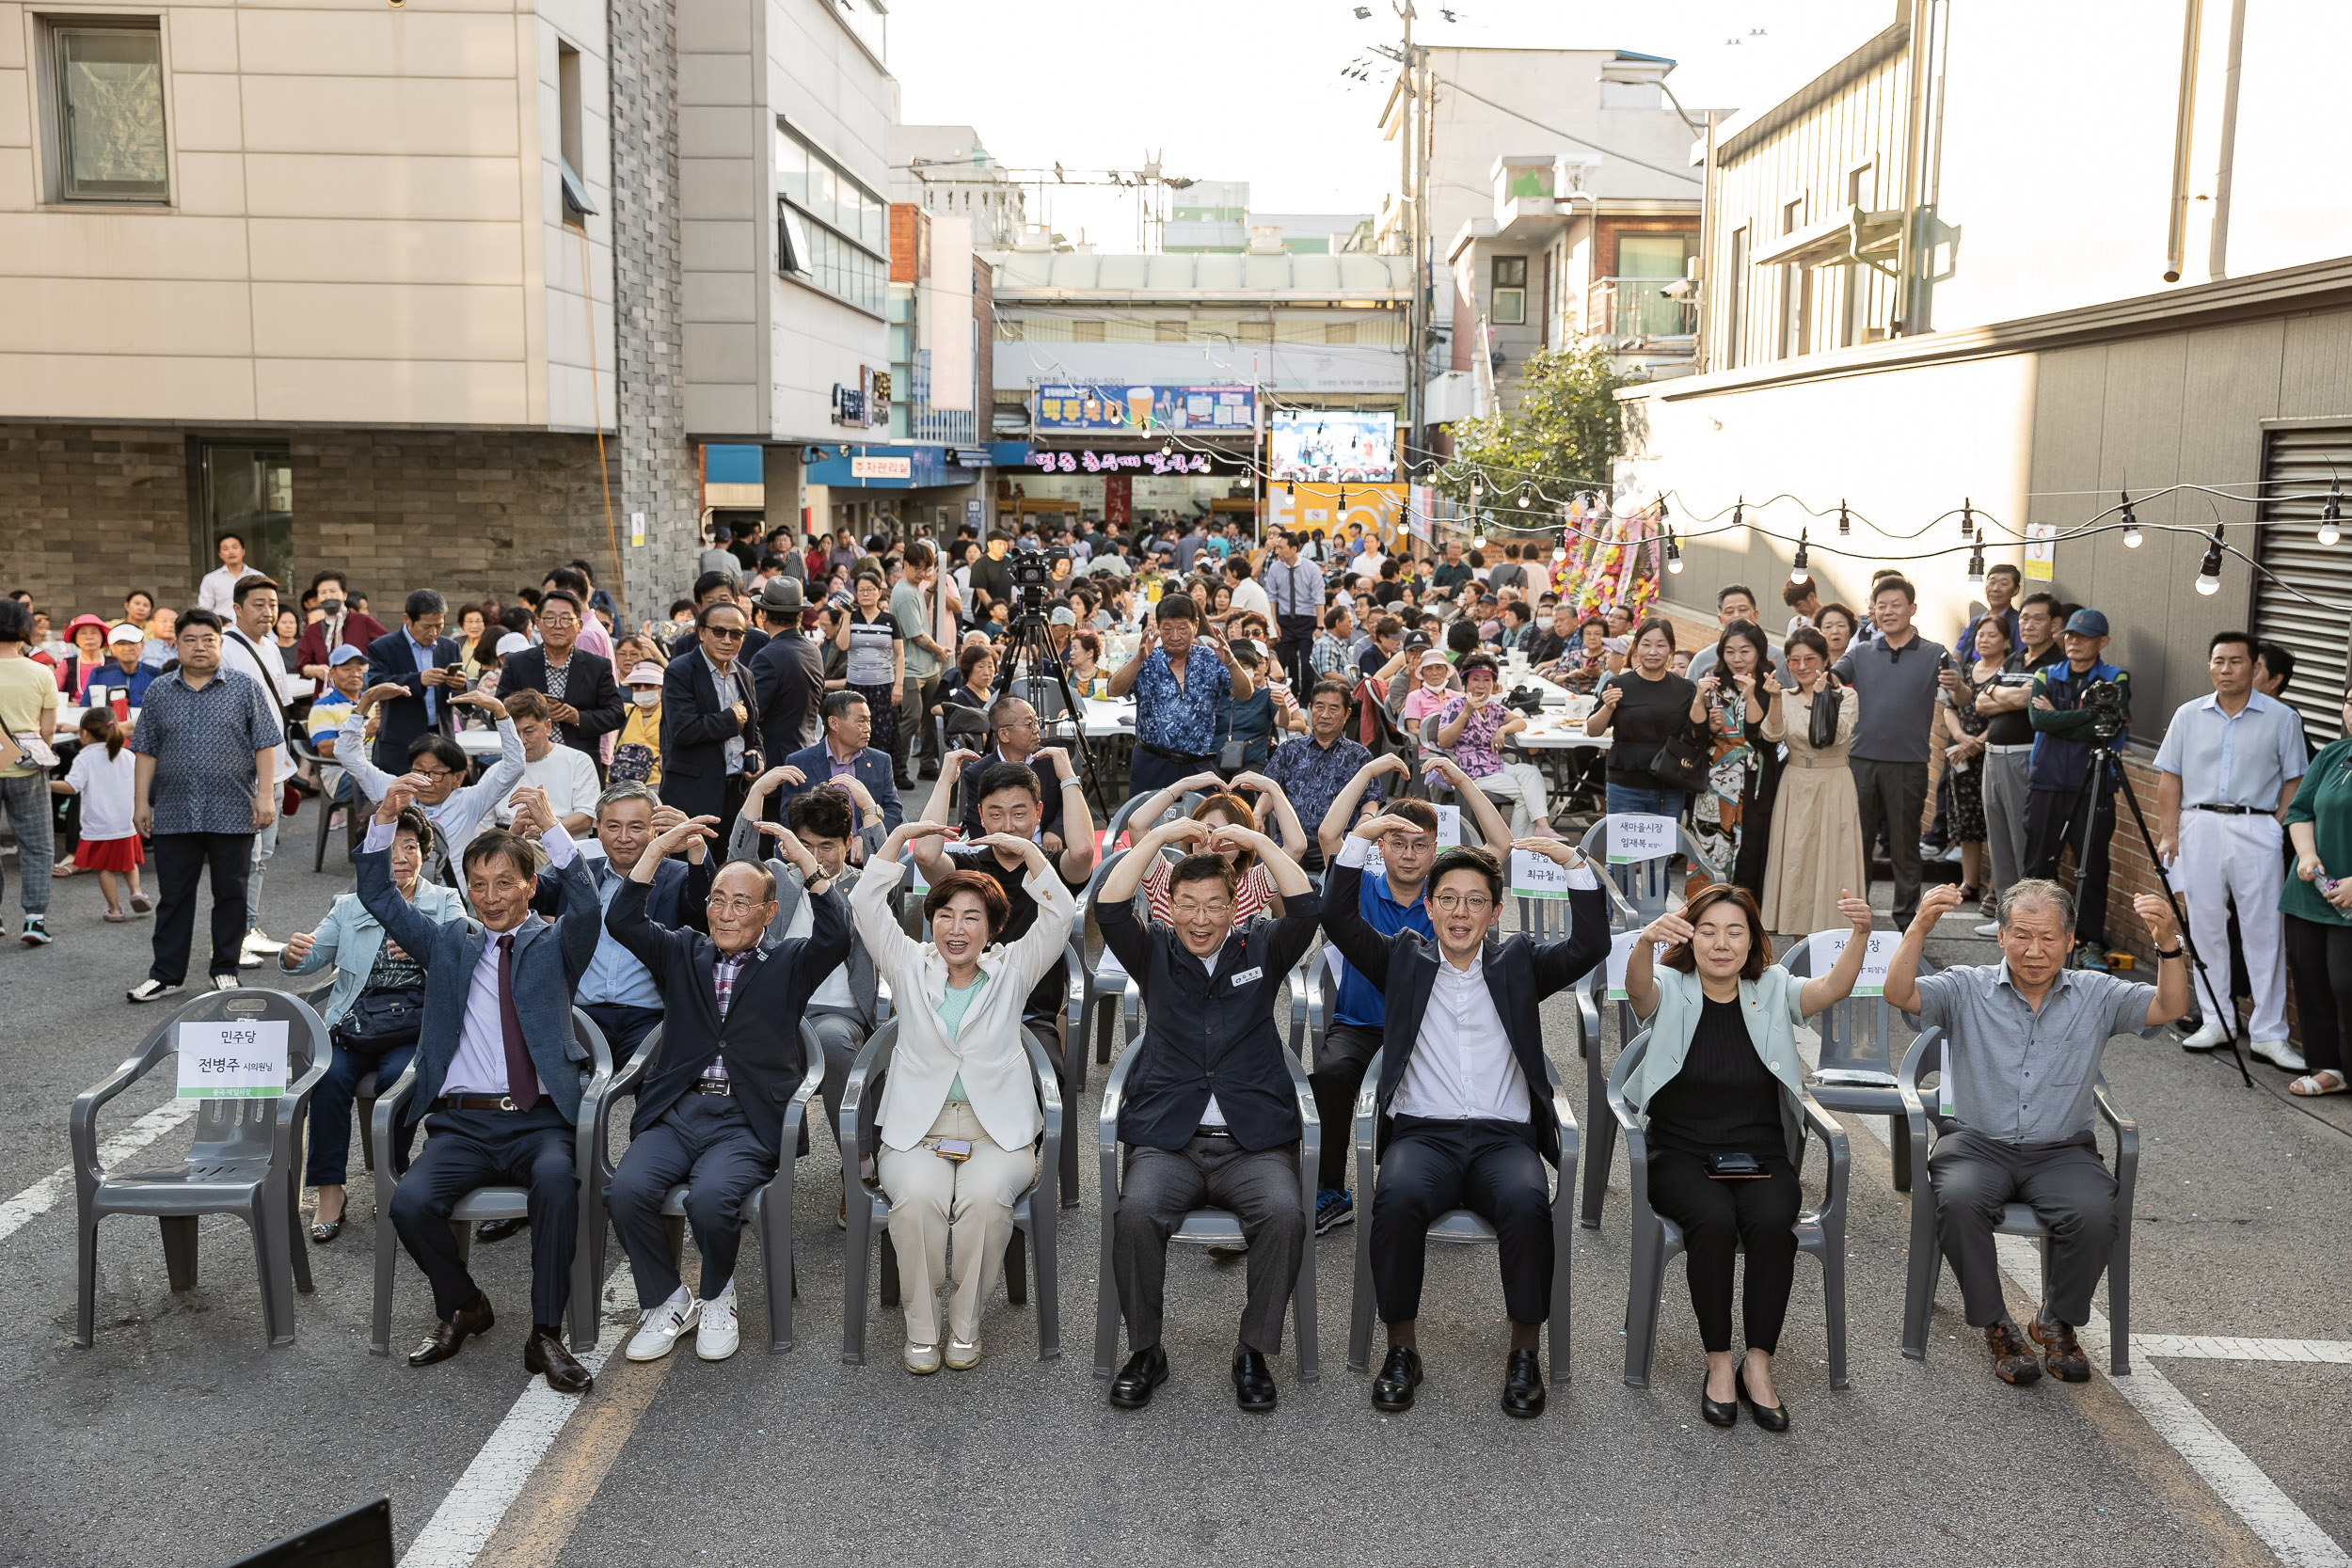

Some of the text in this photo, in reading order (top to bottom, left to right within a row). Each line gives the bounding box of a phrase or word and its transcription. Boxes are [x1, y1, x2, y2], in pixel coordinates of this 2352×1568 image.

[855, 461, 909, 475] 주차관리실
[1619, 822, 1663, 833] 새마을시장
[1621, 838, 1646, 848] 임재복
[1527, 870, 1554, 881] 최규철
[1835, 940, 1881, 953] 자장
[221, 1030, 257, 1044] 민주당
[199, 1057, 273, 1073] 전병주 시의원님
